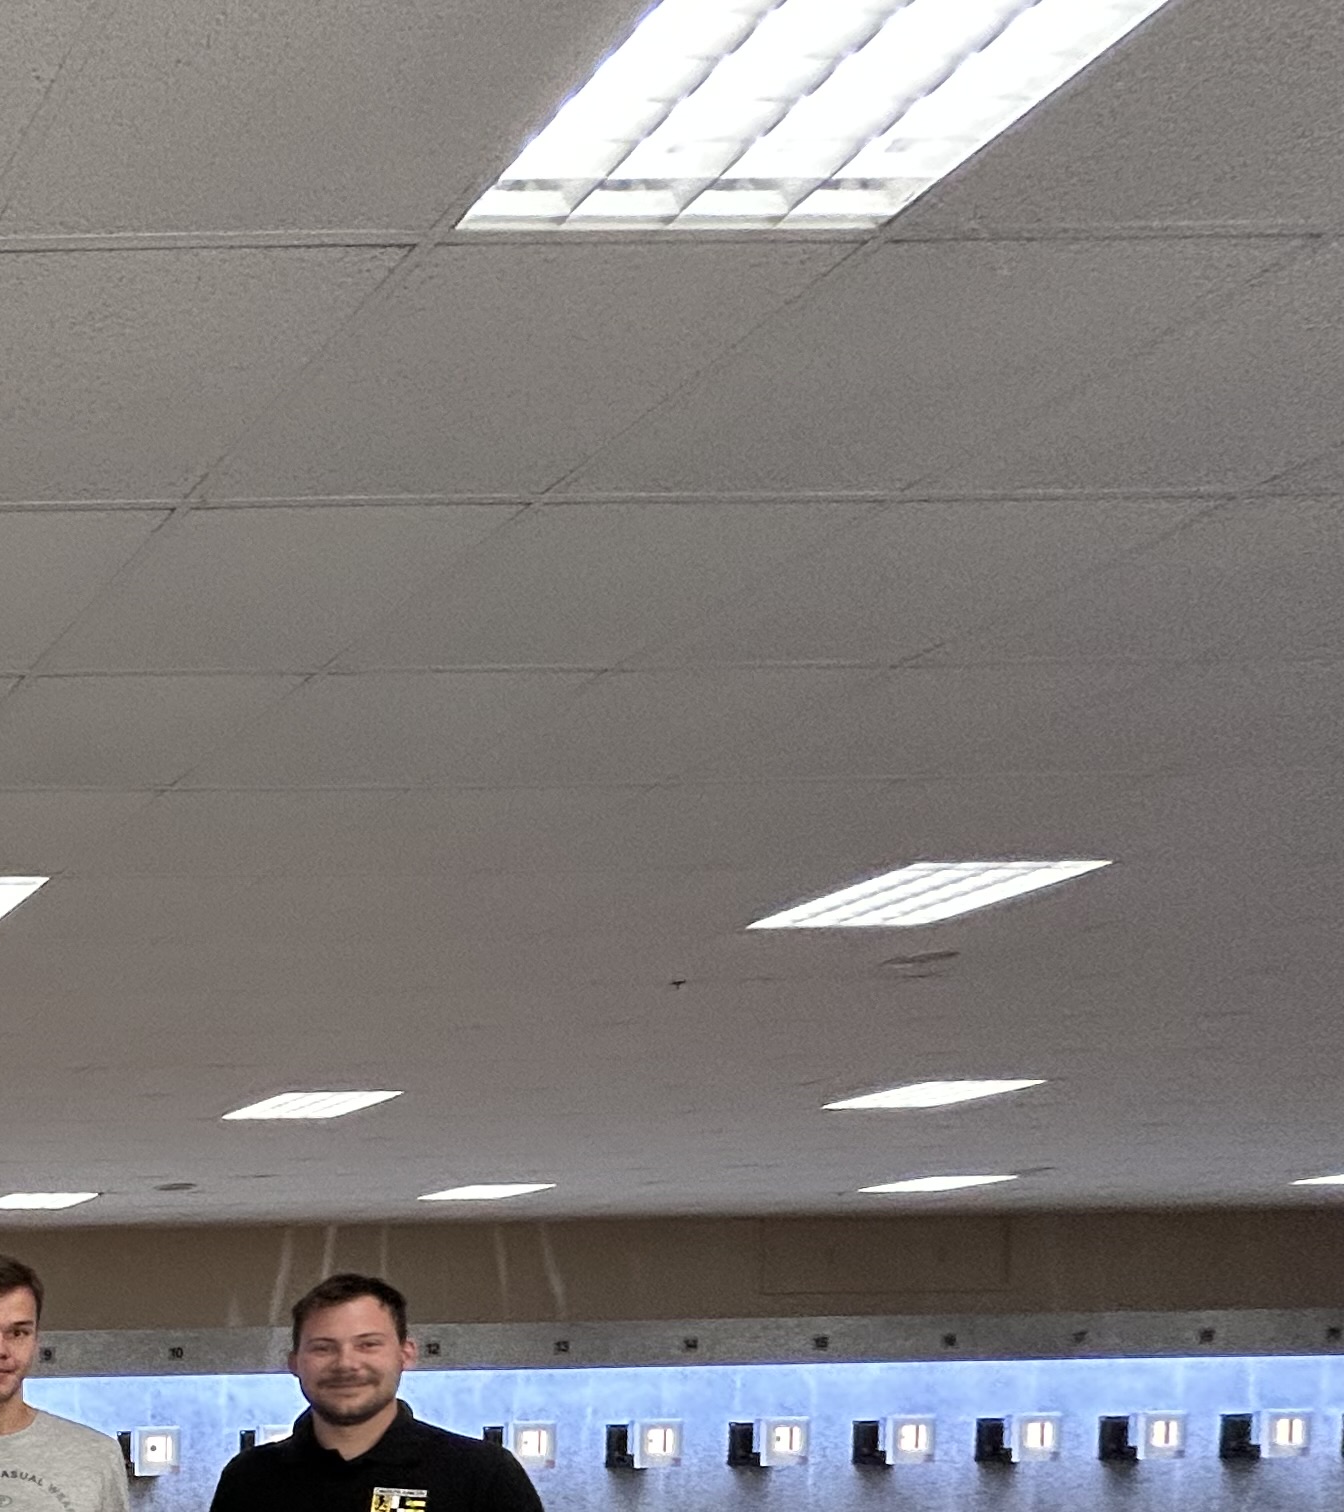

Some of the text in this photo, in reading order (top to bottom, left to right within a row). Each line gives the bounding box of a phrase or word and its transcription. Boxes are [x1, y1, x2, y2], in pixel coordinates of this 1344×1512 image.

[43, 1349, 52, 1362] 9
[168, 1346, 183, 1360] 10
[425, 1342, 441, 1356] 12
